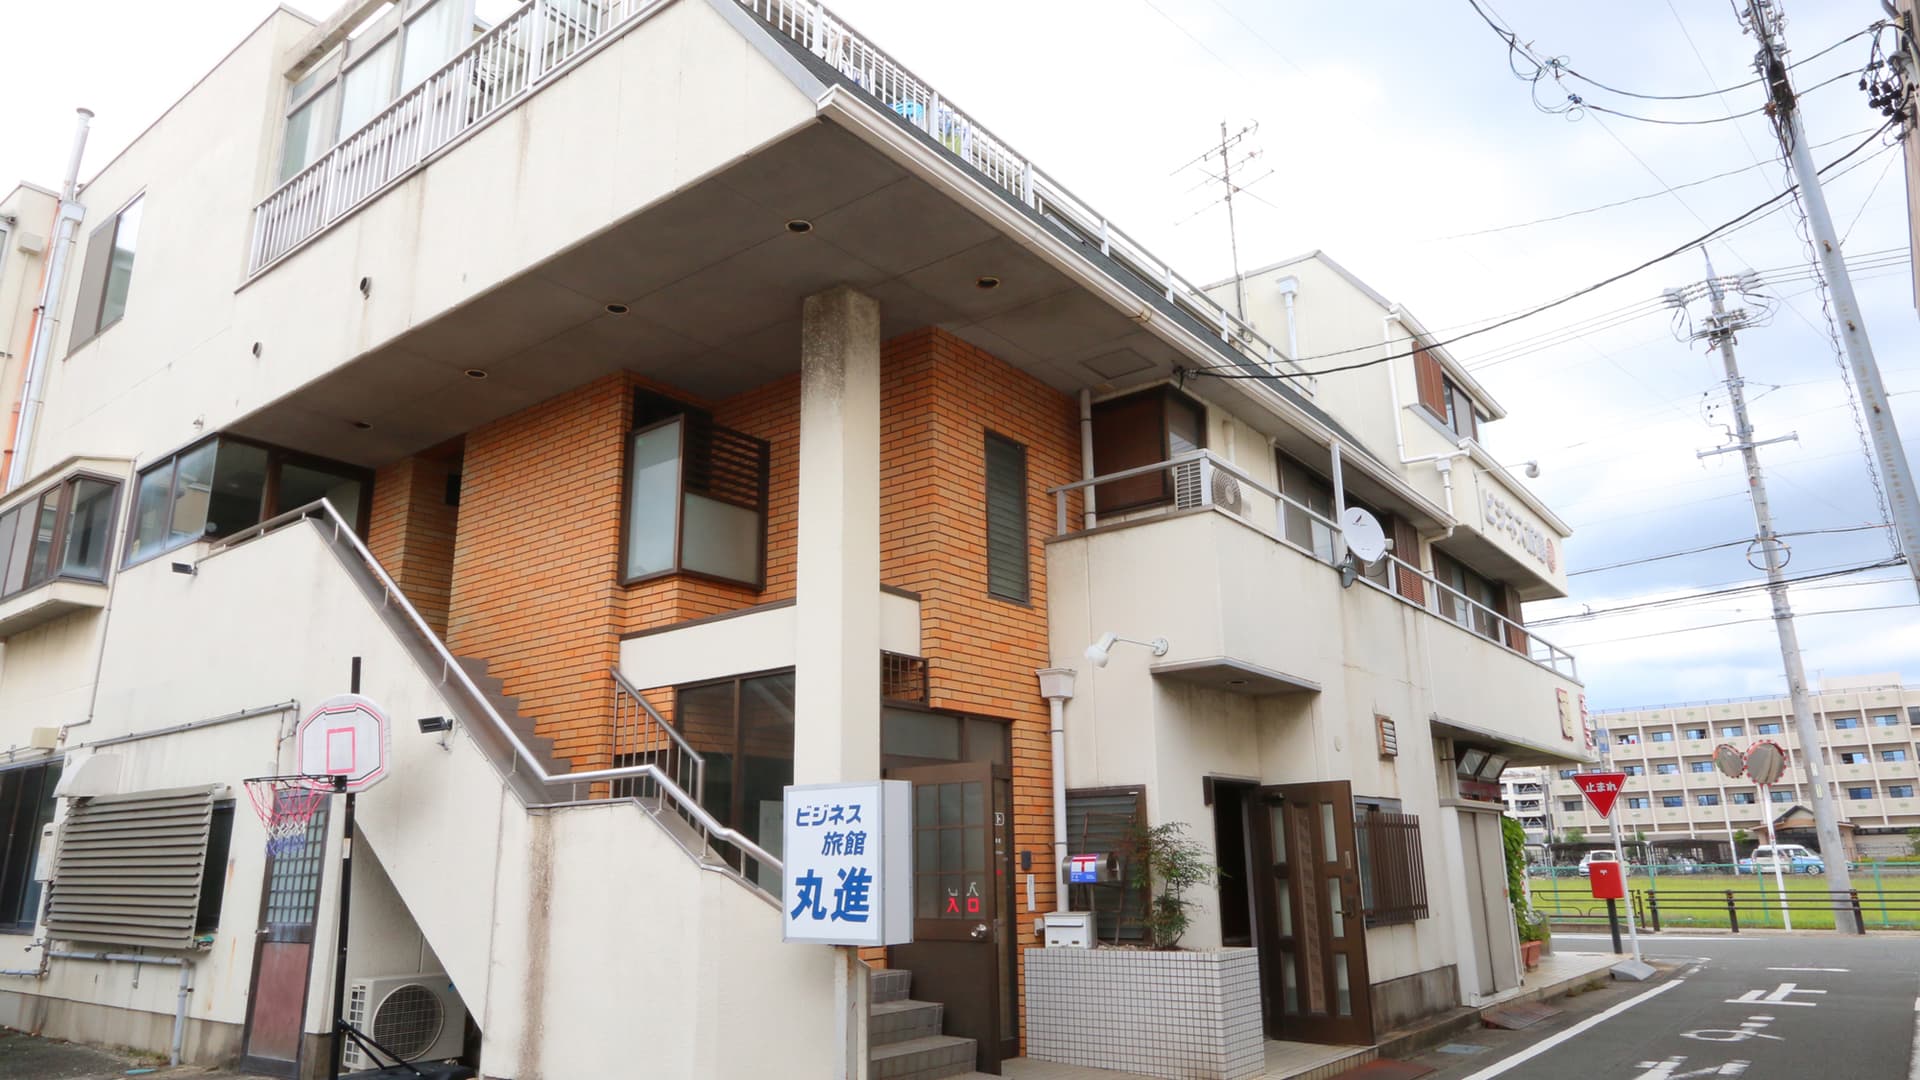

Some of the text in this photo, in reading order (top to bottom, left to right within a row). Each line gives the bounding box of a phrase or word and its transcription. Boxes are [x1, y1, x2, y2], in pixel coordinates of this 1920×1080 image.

[1585, 781, 1618, 793] 止まれ
[796, 804, 861, 827] ビジネス
[821, 830, 867, 856] 旅館
[790, 867, 873, 923] 丸進
[946, 897, 980, 913] 入口
